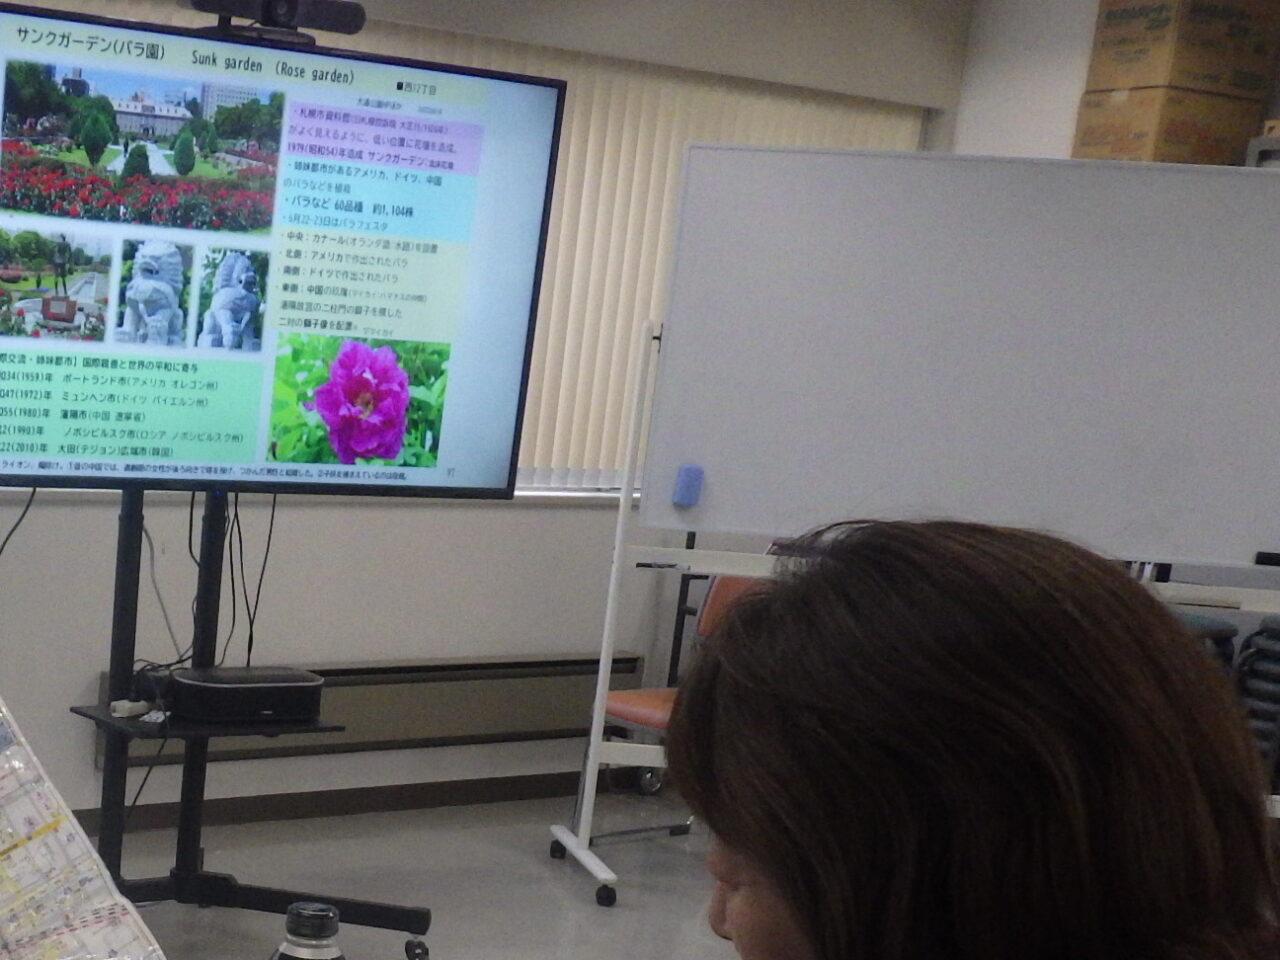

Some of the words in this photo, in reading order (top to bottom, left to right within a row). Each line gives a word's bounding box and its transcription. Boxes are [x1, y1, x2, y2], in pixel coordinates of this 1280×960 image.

[16, 24, 166, 61] サンクガーデン(バラ園)
[191, 50, 219, 67] Sunk
[223, 54, 263, 75] garden
[274, 60, 305, 79] (Rose
[310, 65, 355, 86] garden)
